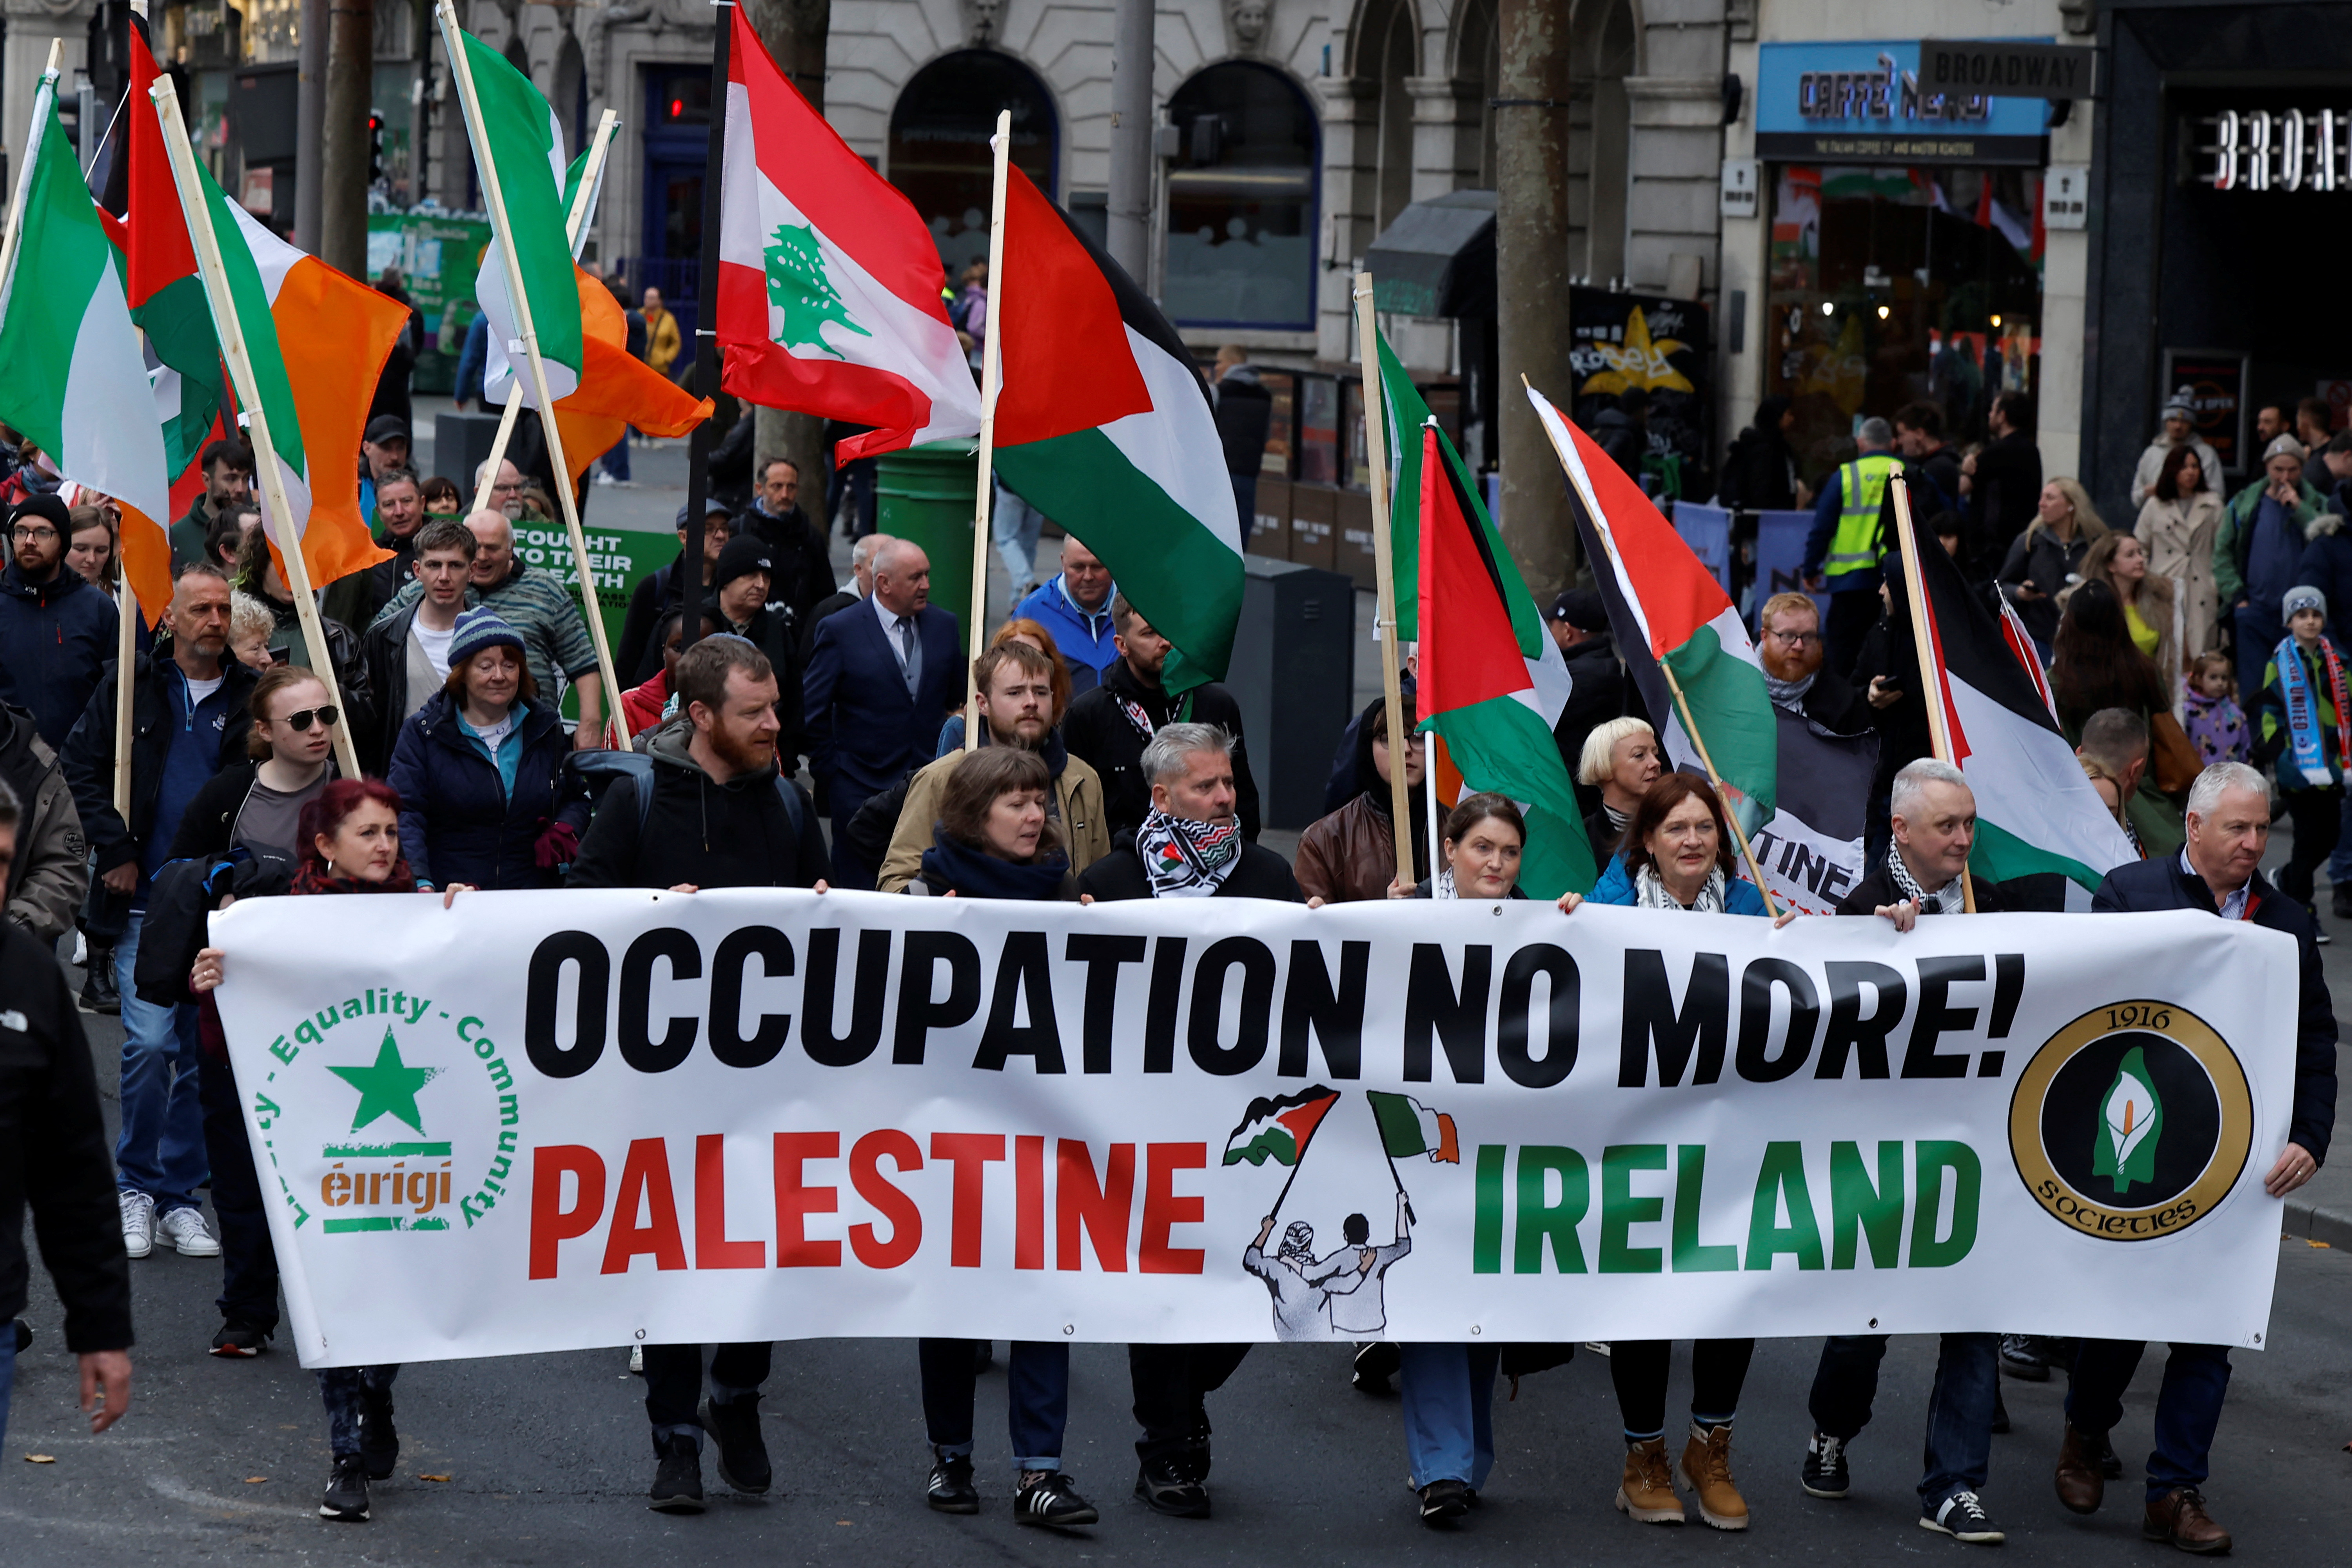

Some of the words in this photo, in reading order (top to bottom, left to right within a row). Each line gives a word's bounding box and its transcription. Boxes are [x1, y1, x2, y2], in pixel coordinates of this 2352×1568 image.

[1935, 52, 2078, 87] BROADWAY
[2214, 107, 2352, 192] BROA
[512, 547, 545, 564] TO
[549, 568, 624, 589] EATH
[2290, 686, 2308, 730] UNITED
[524, 925, 1371, 1080] OCCUPATION
[1402, 942, 1581, 1089] NO
[1617, 948, 2025, 1088] MORE!
[2106, 1005, 2172, 1030] 1916
[269, 987, 431, 1065] Equality
[457, 1016, 519, 1229] Community
[528, 1129, 1207, 1281] PALESTINE
[1473, 1140, 1982, 1274] IRELAND
